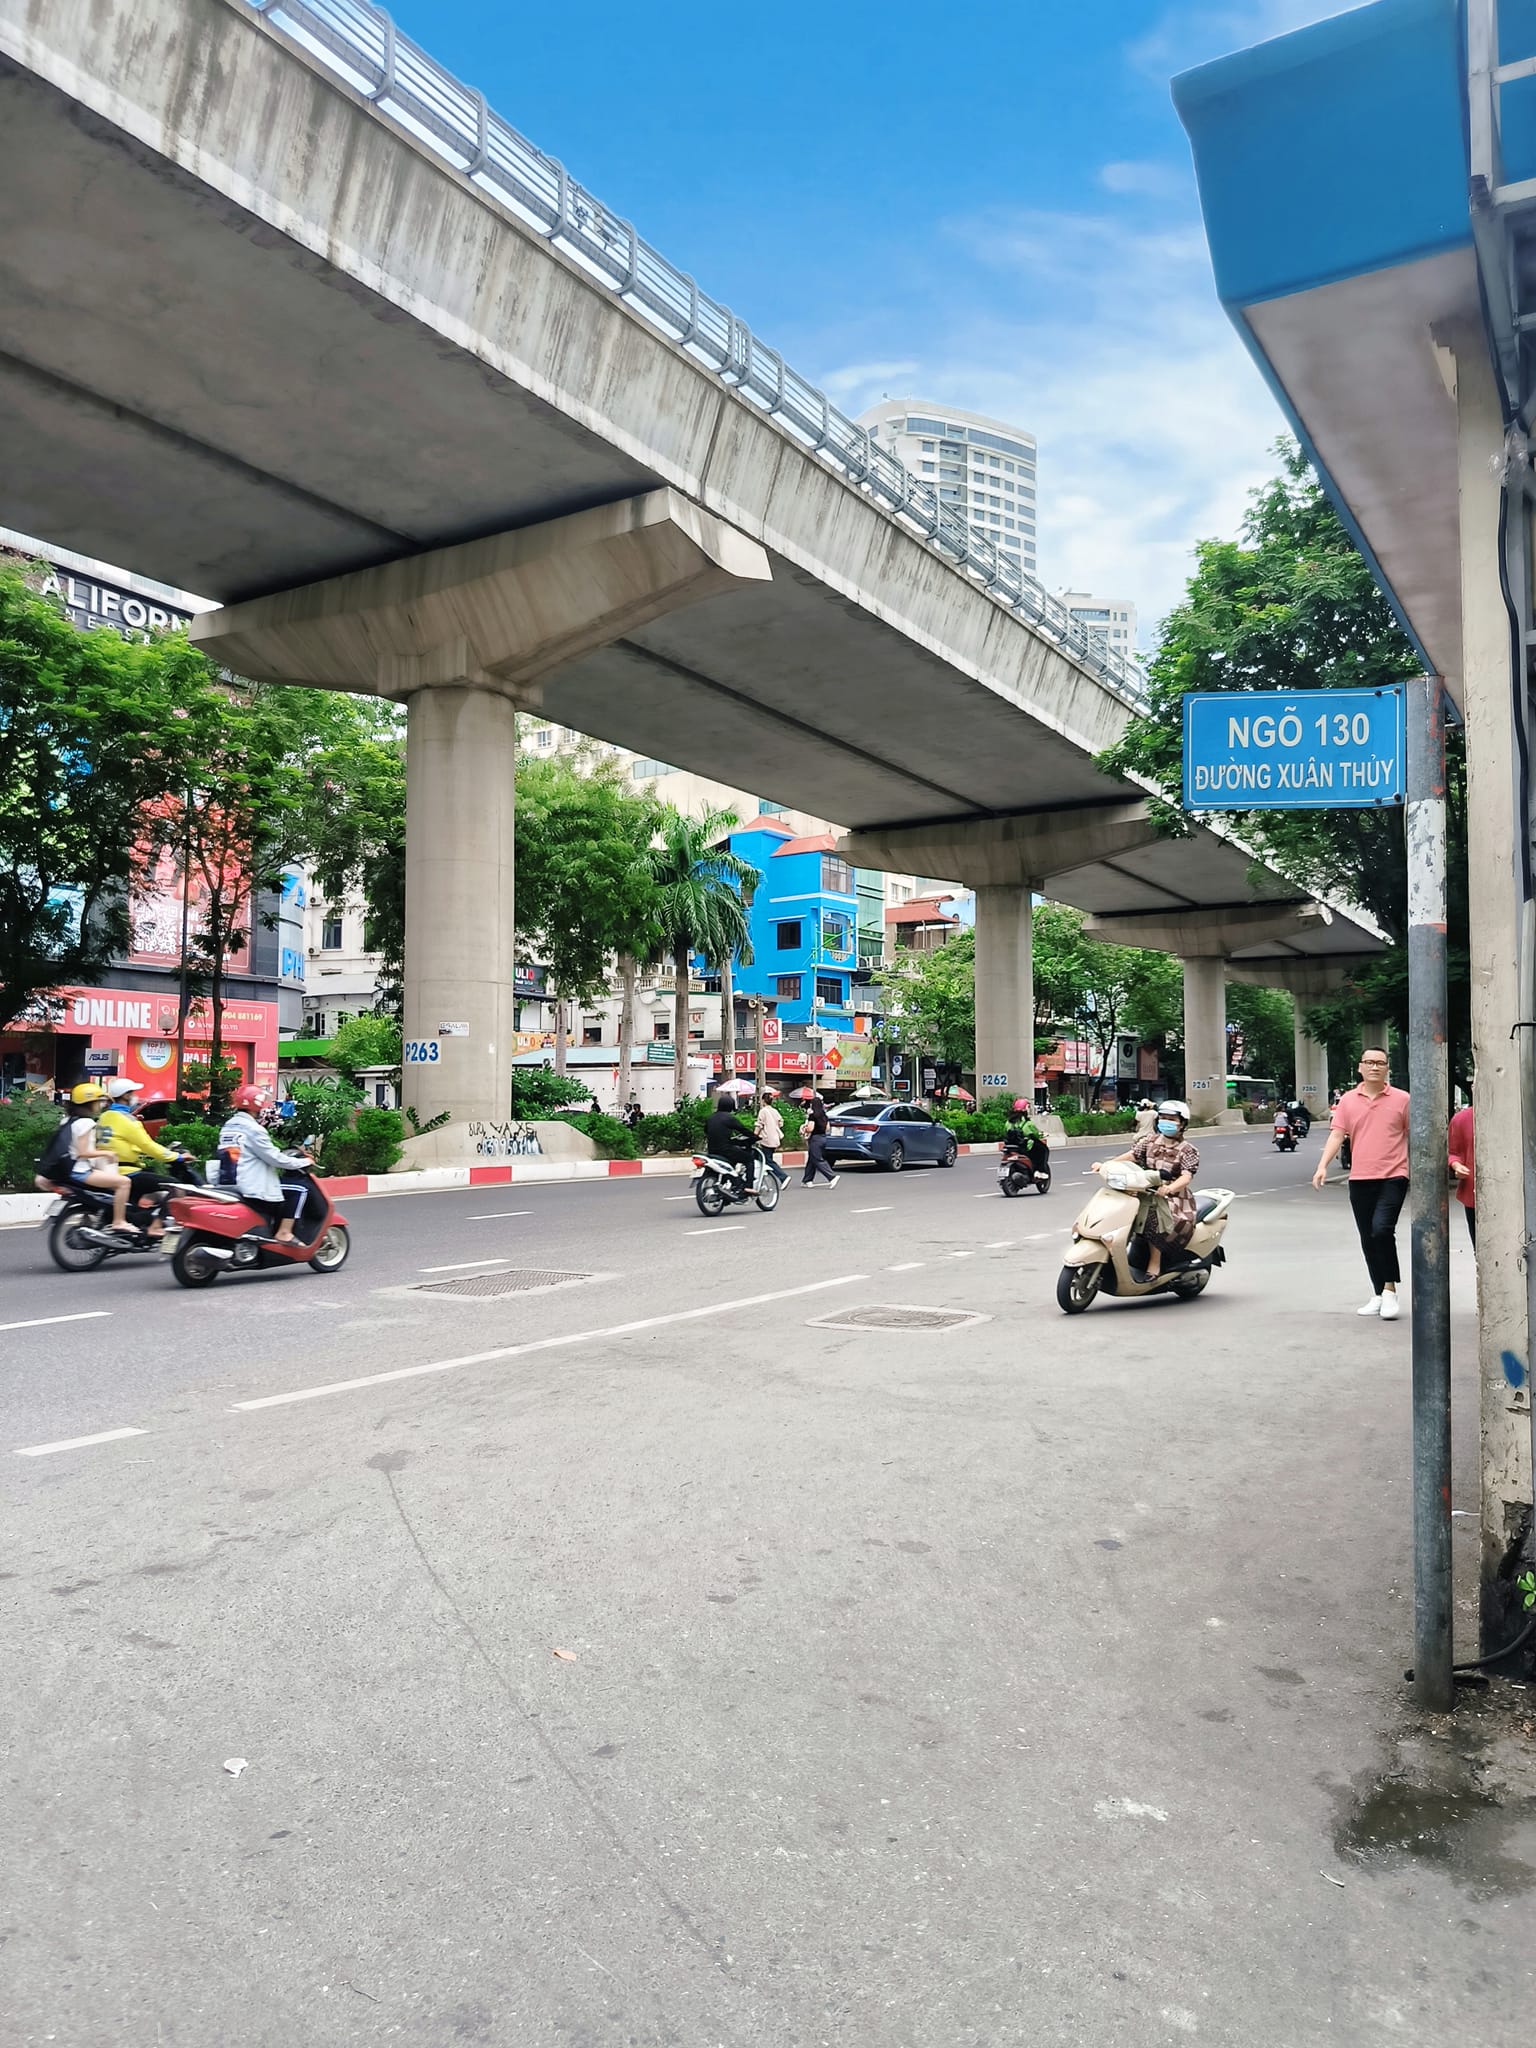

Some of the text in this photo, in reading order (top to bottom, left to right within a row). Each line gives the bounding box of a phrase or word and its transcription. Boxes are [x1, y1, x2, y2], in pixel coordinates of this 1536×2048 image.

[1228, 705, 1370, 749] NGÕ 130
[1195, 754, 1394, 791] ĐƯỜNG XUÂN THỦY
[73, 997, 152, 1029] ONLINE
[88, 1053, 110, 1061] ASUS
[405, 1041, 439, 1062] P263
[982, 1074, 1007, 1086] P262
[1192, 1080, 1210, 1089] P261
